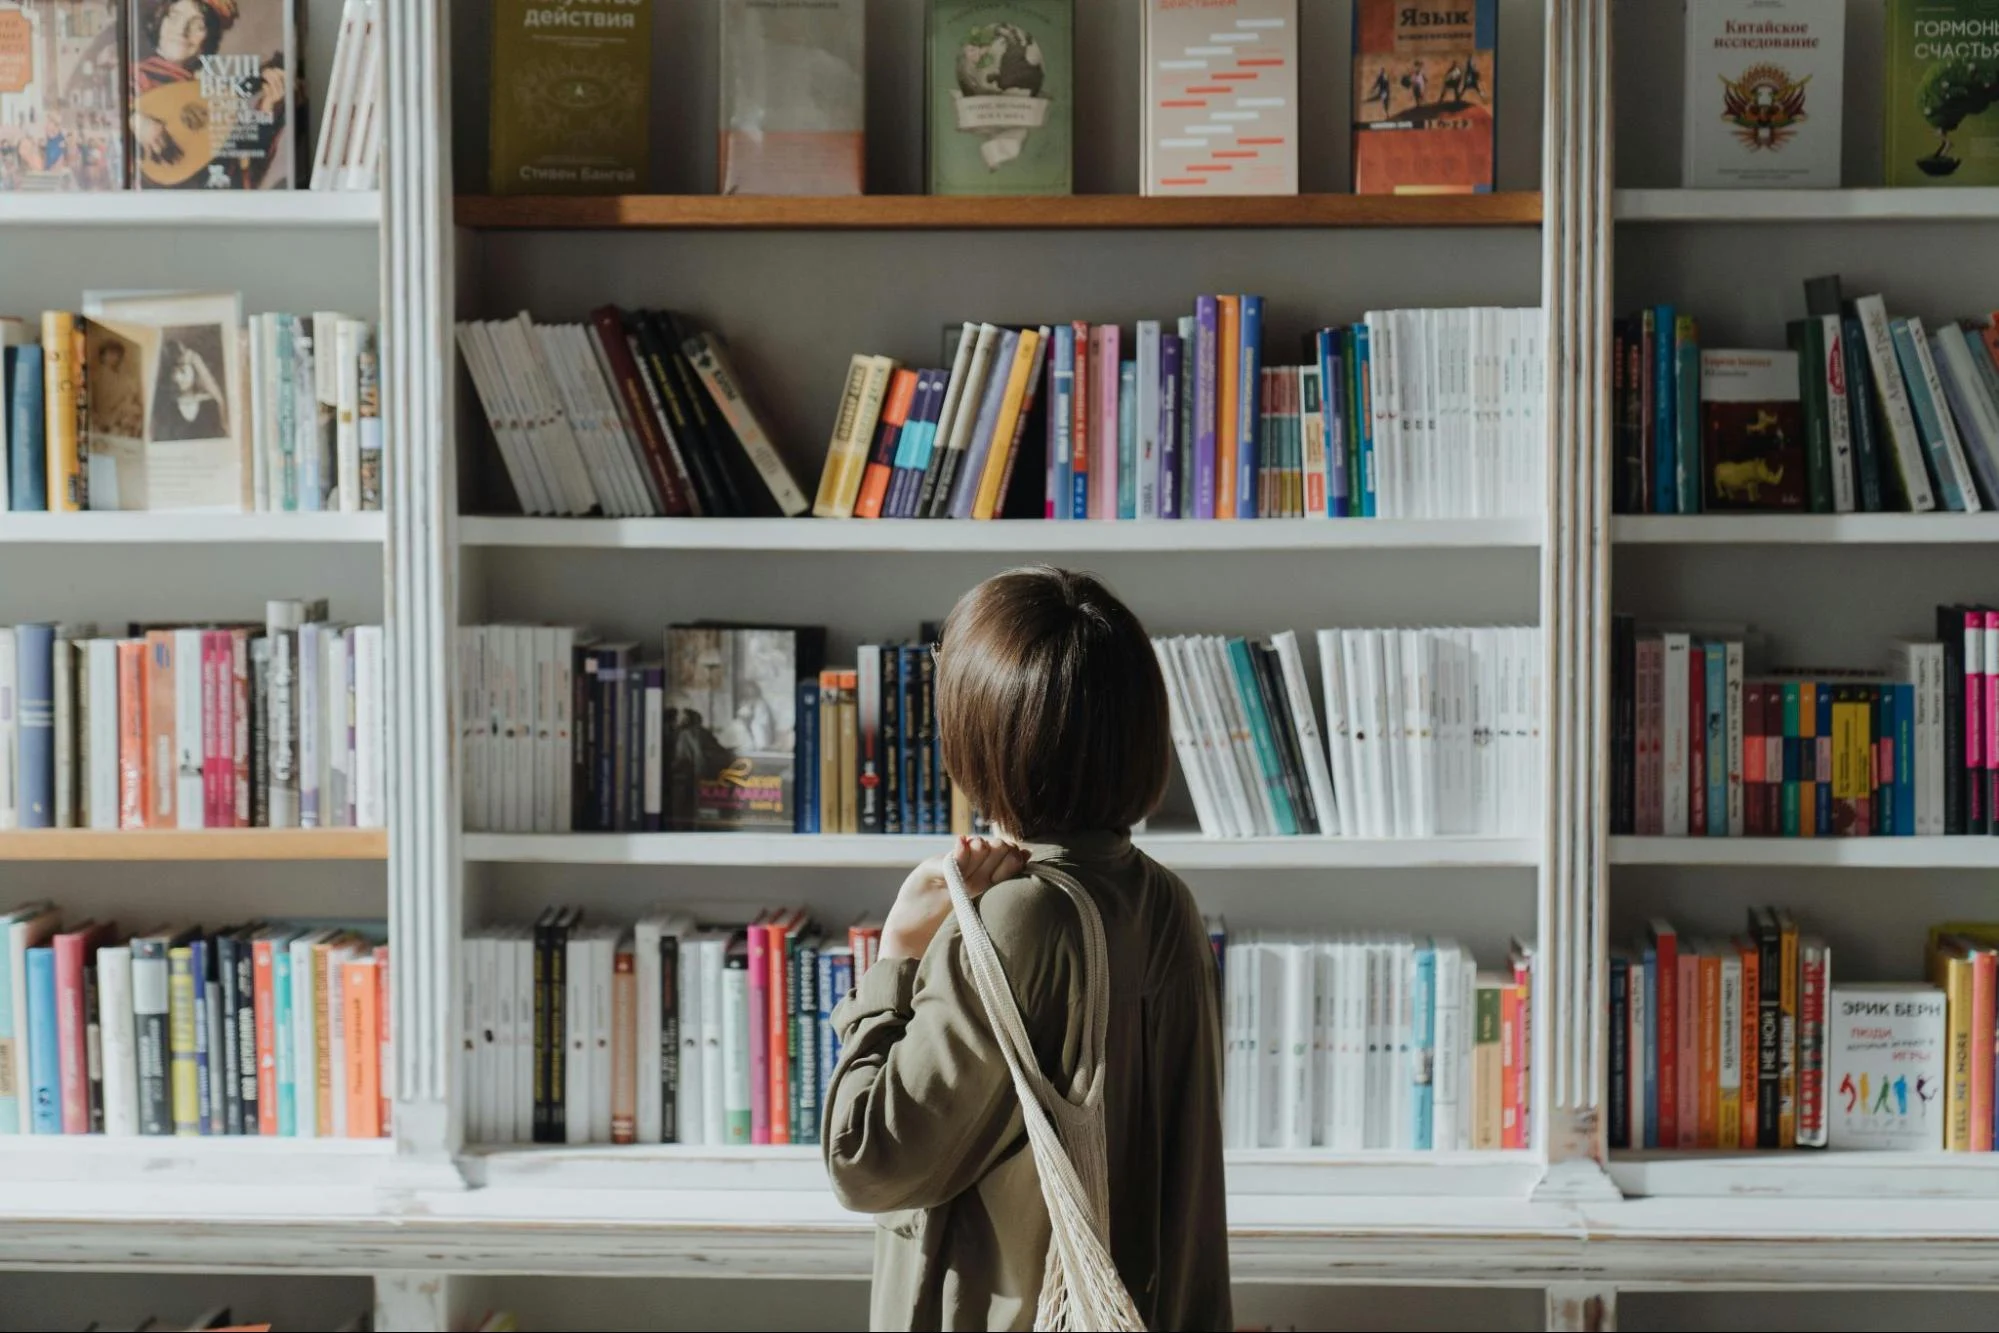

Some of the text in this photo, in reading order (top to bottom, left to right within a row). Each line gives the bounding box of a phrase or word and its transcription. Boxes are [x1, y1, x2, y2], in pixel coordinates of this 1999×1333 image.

[523, 7, 636, 29] действия
[1400, 8, 1470, 26] Язык
[1725, 19, 1809, 34] Китайское
[1713, 36, 1820, 49] исследование
[519, 165, 578, 181] Стивен
[1746, 967, 1757, 1018] ЭТИКЕТ
[1842, 1001, 1940, 1017] ЭРИК БЕРН
[1760, 1010, 1776, 1070] НЕ НОЙ
[1956, 1031, 1967, 1073] MORE
[1955, 1083, 1967, 1100] ME
